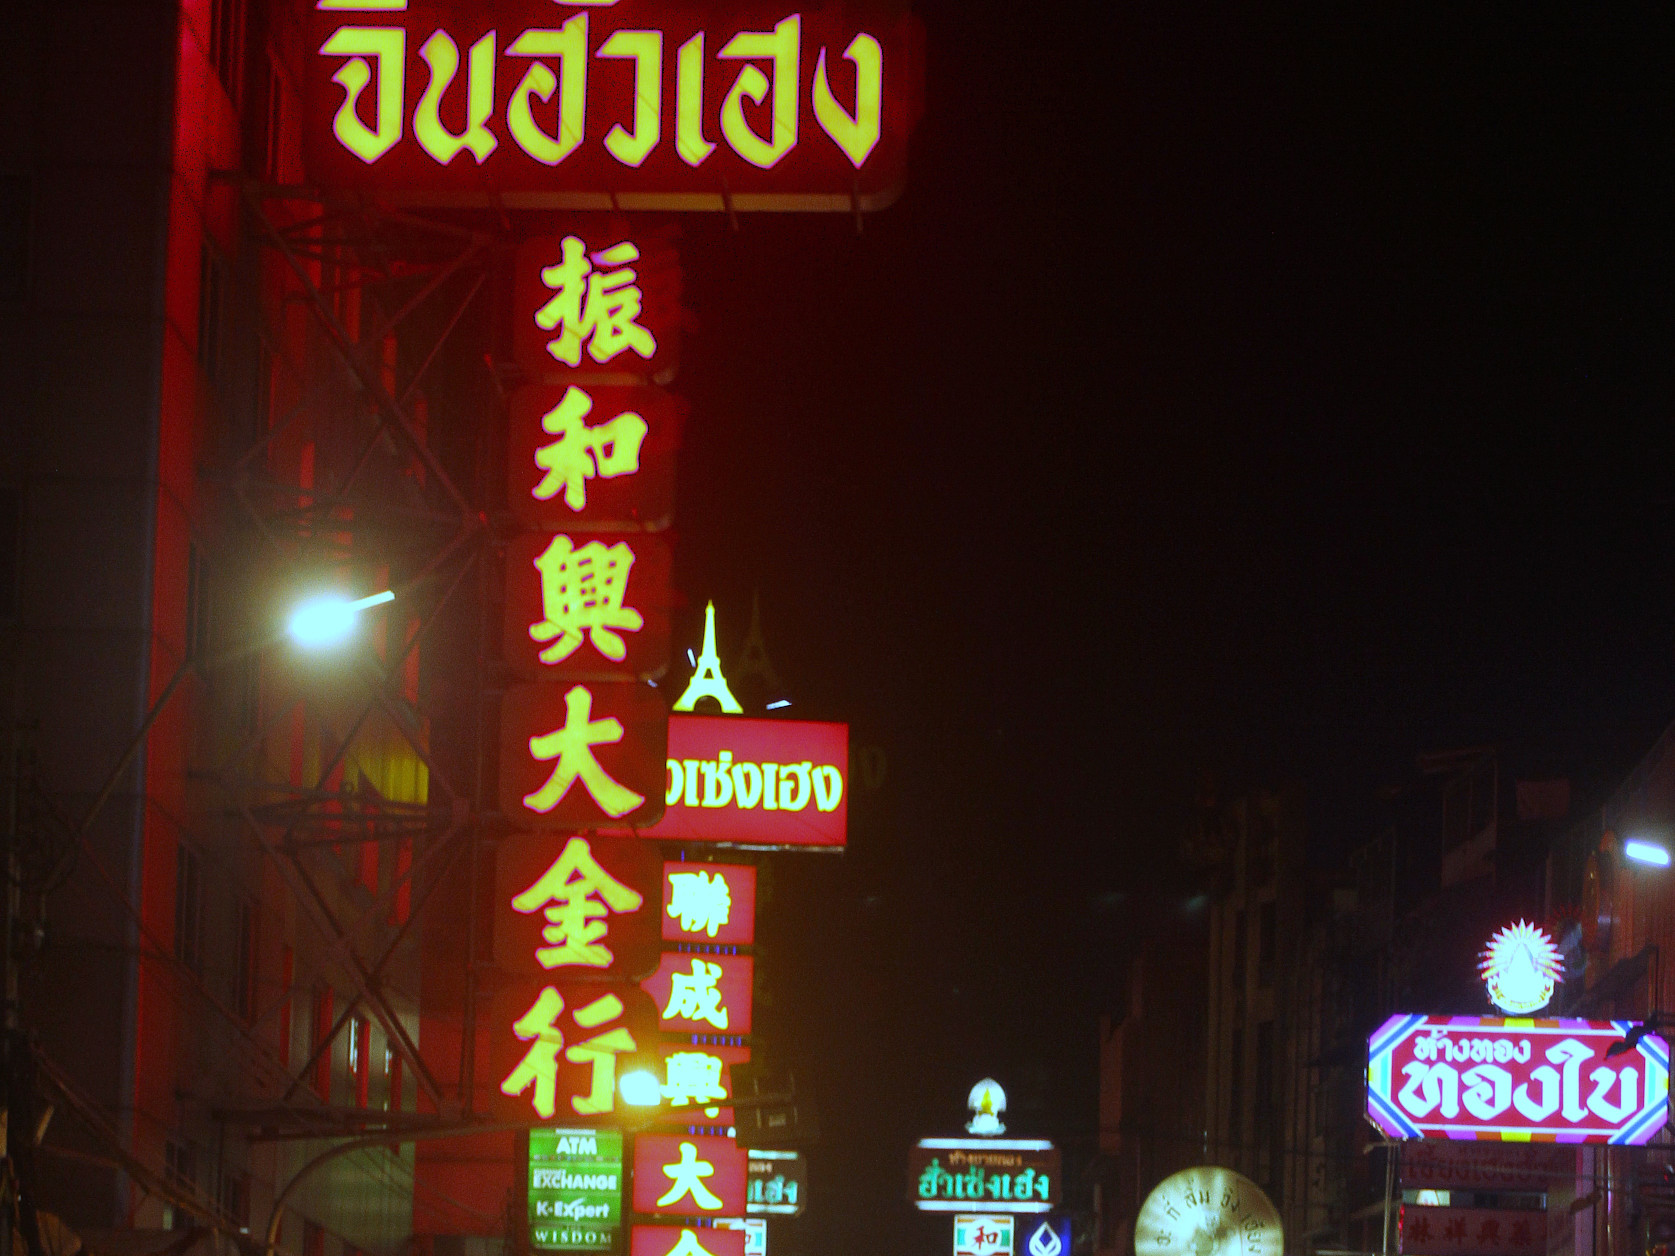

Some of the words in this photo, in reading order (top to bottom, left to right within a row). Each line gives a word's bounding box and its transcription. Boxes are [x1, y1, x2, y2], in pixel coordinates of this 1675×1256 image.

[500, 235, 658, 1119] 振和興大金行
[1413, 1028, 1531, 1064] ห้างทอง
[556, 1136, 598, 1155] ATM
[533, 1172, 618, 1191] EXCHANGE
[535, 1230, 612, 1244] WISDOM
